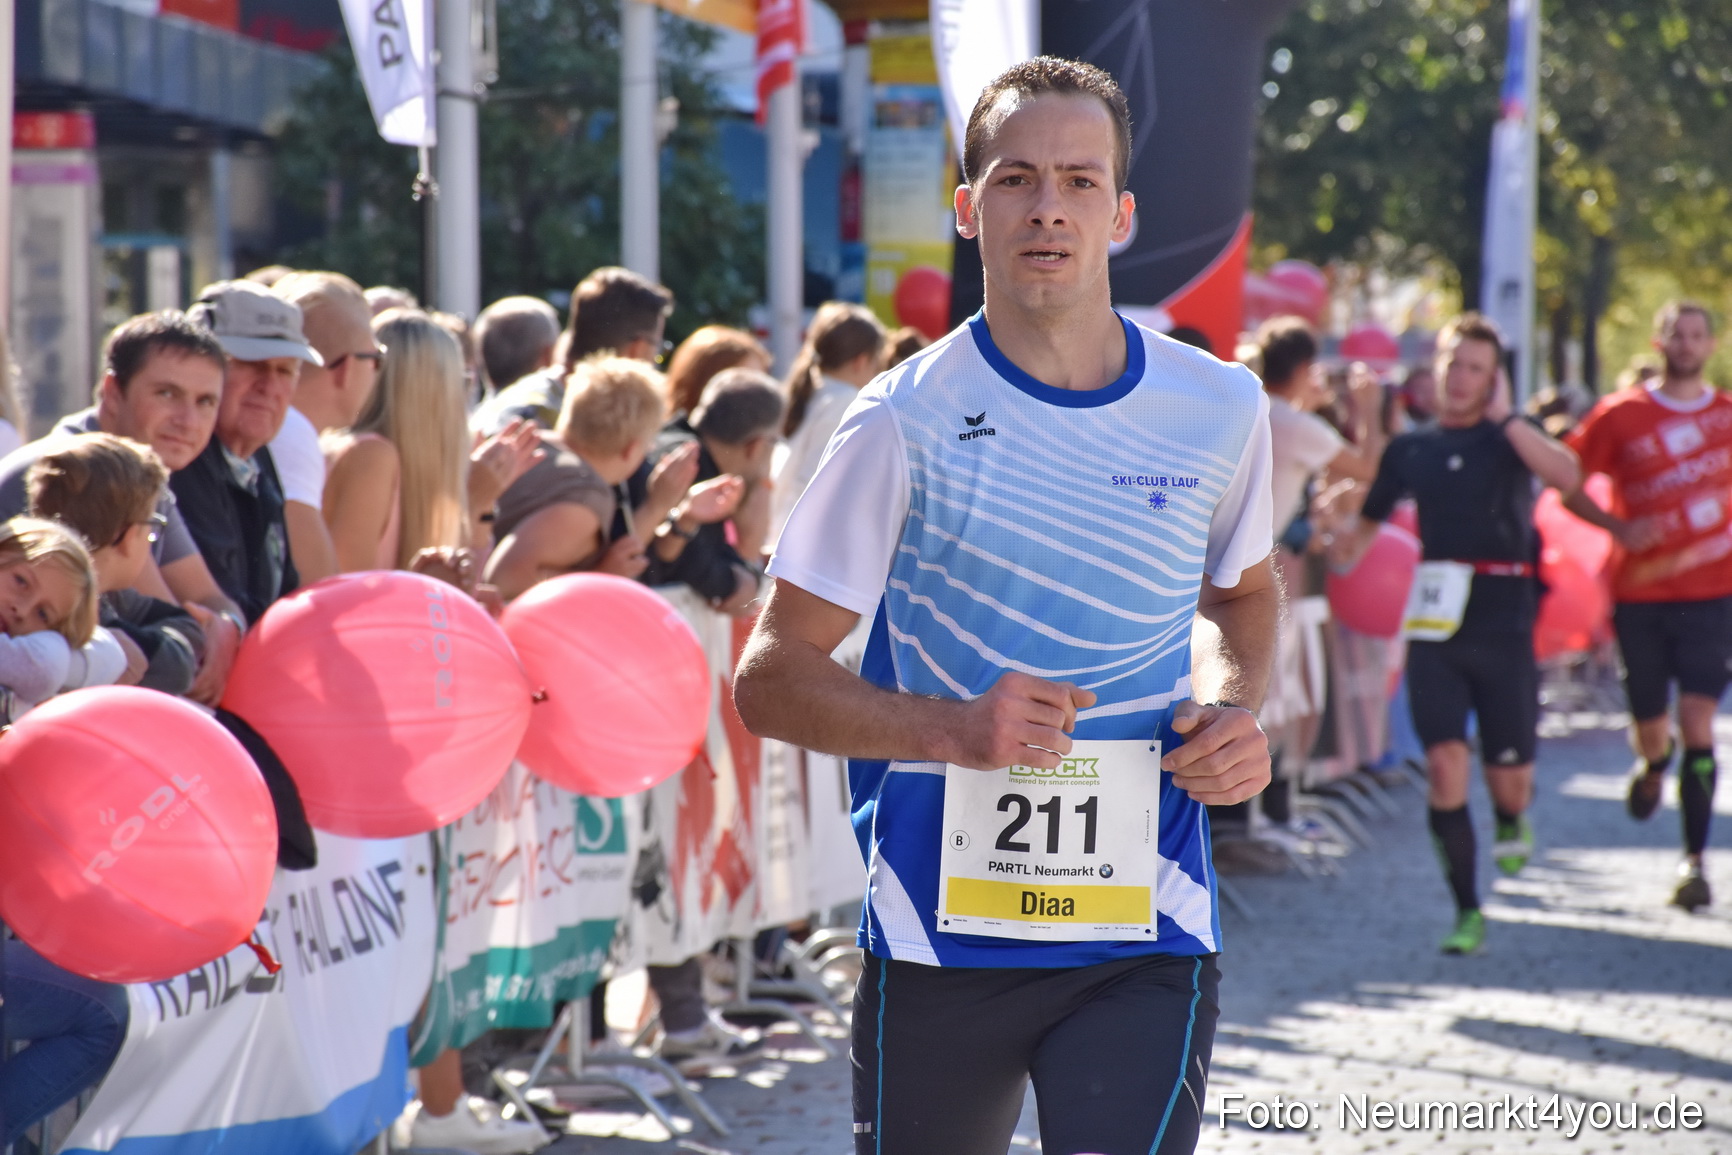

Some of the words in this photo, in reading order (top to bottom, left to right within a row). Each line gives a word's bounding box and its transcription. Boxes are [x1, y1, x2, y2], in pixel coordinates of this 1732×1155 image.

[958, 427, 996, 441] erima
[1111, 475, 1169, 487] SKI-CLUB
[1171, 477, 1200, 488] LAUF
[1008, 776, 1037, 785] inspired
[1038, 777, 1047, 786] by
[1048, 778, 1069, 786] smart
[994, 793, 1098, 854] 211
[955, 835, 964, 846] B
[988, 861, 1032, 875] PARTL
[1034, 865, 1095, 876] Neumarkt
[1020, 890, 1076, 917] Diaa
